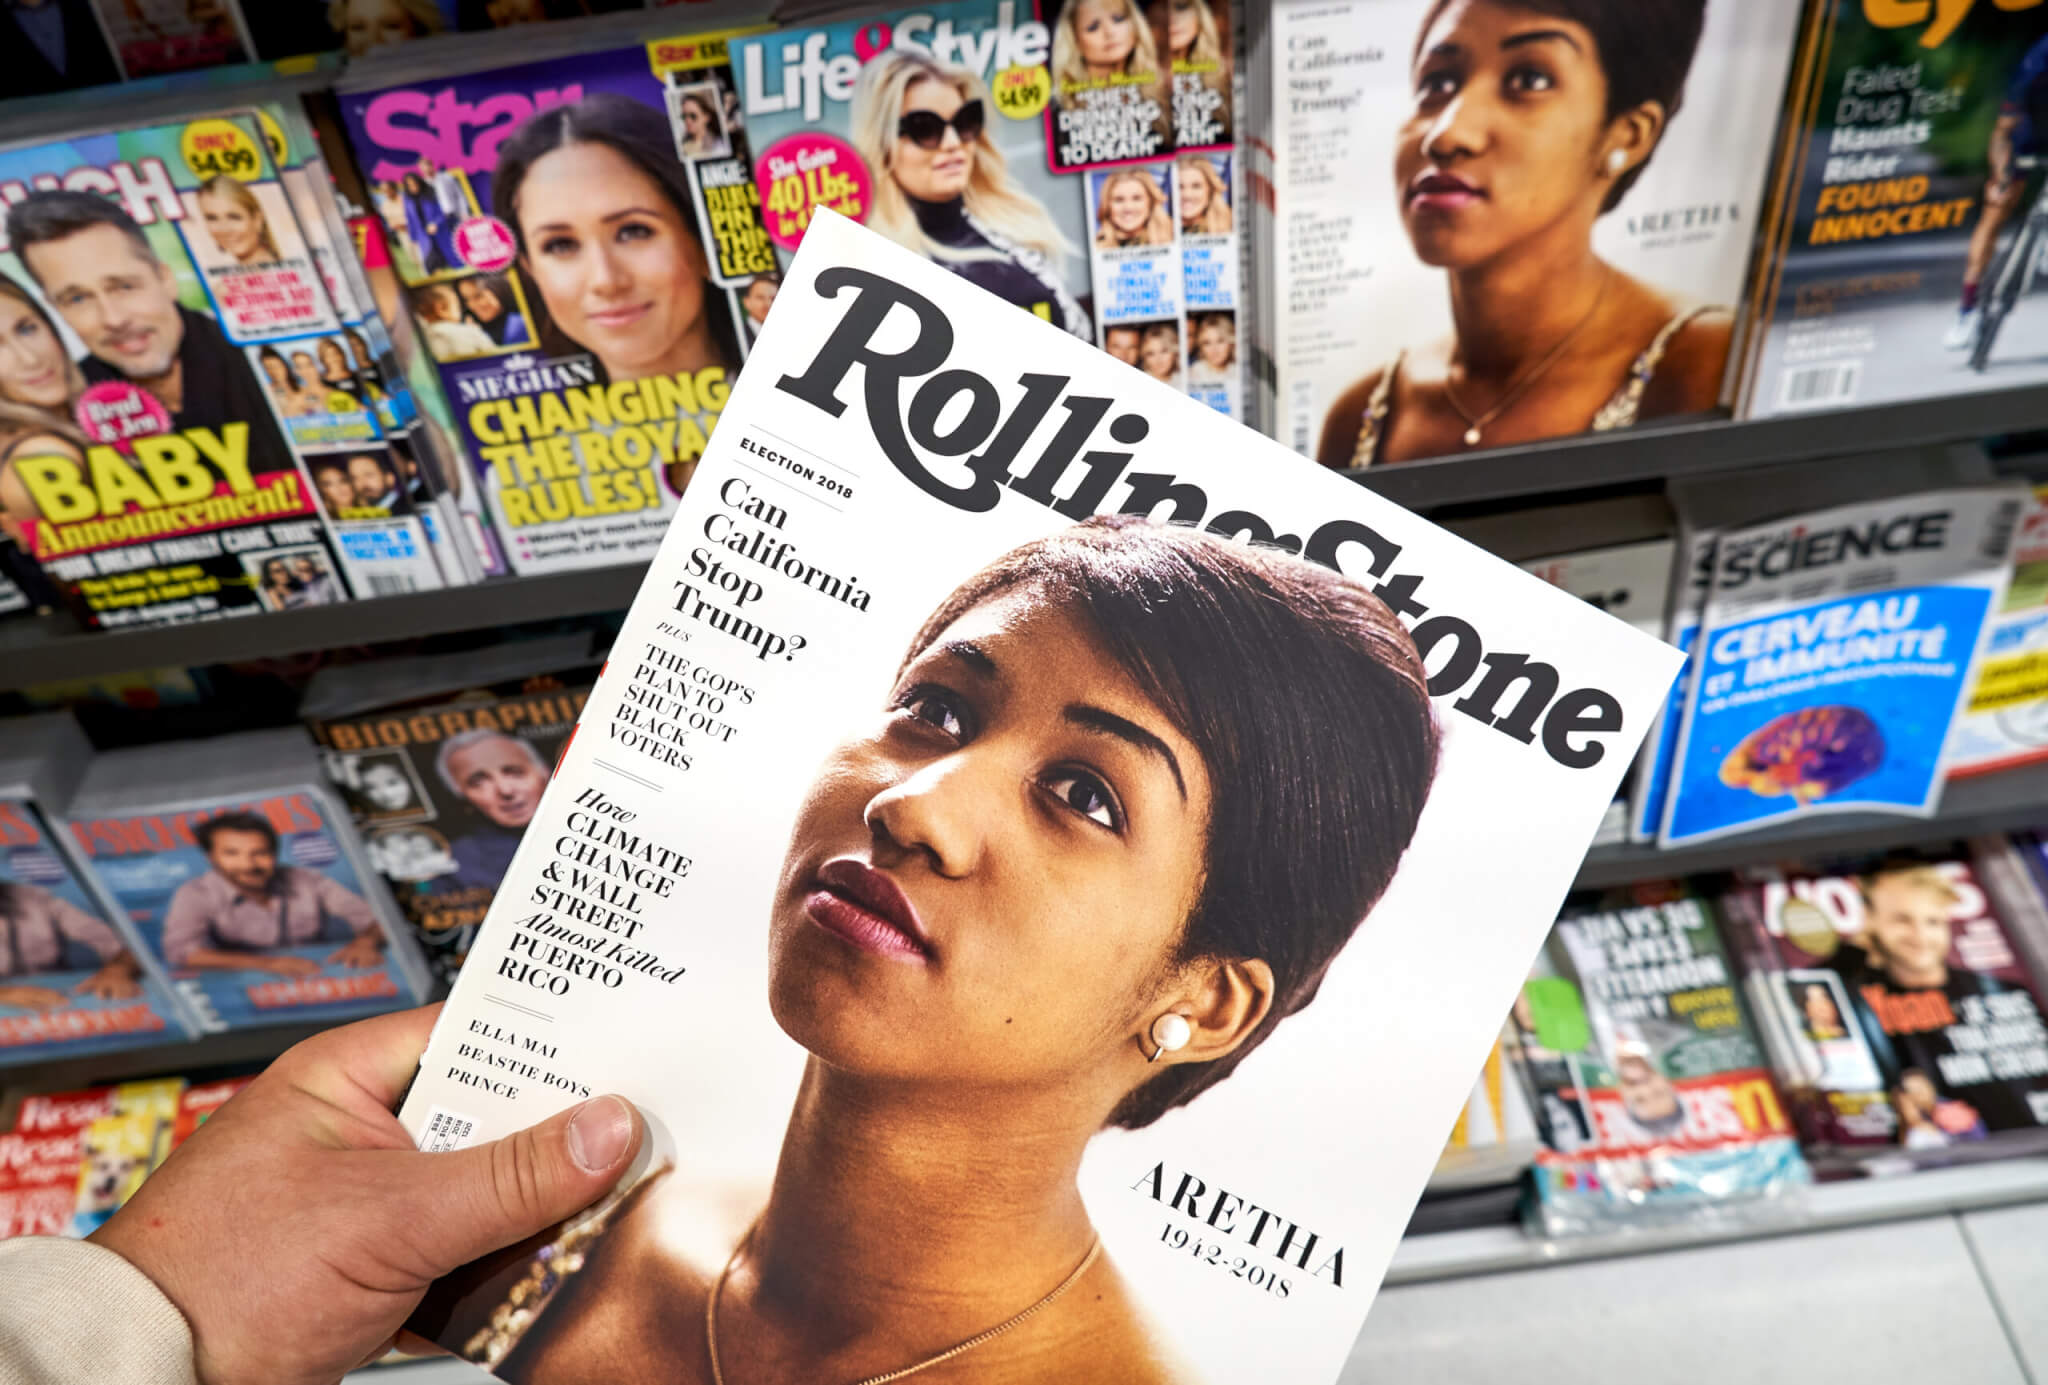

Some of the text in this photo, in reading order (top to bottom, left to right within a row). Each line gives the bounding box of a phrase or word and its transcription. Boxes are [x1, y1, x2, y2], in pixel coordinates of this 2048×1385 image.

[1843, 61, 1922, 95] Failed
[1830, 119, 1932, 154] Haunts
[1835, 94, 1905, 125] Drug
[767, 174, 805, 217] 40
[1816, 173, 1930, 215] FOUND
[1823, 153, 1900, 184] Rider
[1808, 197, 1975, 245] INNOCENT
[458, 361, 596, 403] MEGHAN
[468, 366, 732, 445] CHANGING
[13, 421, 258, 526] BABY
[480, 433, 579, 487] THE
[740, 437, 854, 499] ELECTION 2018
[36, 472, 303, 559] Announcement!
[500, 467, 662, 529] RULES!
[720, 478, 788, 530] Can
[684, 547, 763, 609] Stop
[703, 513, 872, 612] California
[656, 621, 693, 642] PLUS
[672, 580, 807, 662] Trump?
[1712, 594, 1920, 665] CERVEAU
[646, 643, 756, 705] THE GOP'S
[1704, 671, 1736, 697] ET
[1744, 623, 1947, 686] IMMUNITÉ
[624, 683, 737, 744] SHUT OUT
[634, 663, 724, 714] PLAN TO
[329, 692, 588, 750] BIOGRAPHI
[609, 722, 693, 772] VOTERS
[616, 703, 690, 747] BLACK
[573, 787, 637, 823] How
[555, 836, 675, 899] CHANGE
[567, 811, 693, 878] CLIMATE
[530, 884, 644, 940] STREET
[542, 860, 643, 915] & WALL
[496, 956, 570, 996] RICO
[509, 932, 624, 989] PUERTO
[514, 912, 687, 985] Almost Killed
[468, 1019, 559, 1059] ELLA MAI
[447, 1066, 519, 1100] PRINCE
[458, 1043, 592, 1098] BEASTIE BOYS
[439, 1116, 453, 1138] $10.99
[451, 1119, 464, 1136] 2018
[1129, 1160, 1345, 1289] ARETHA
[1159, 1222, 1293, 1299] 1942-2018
